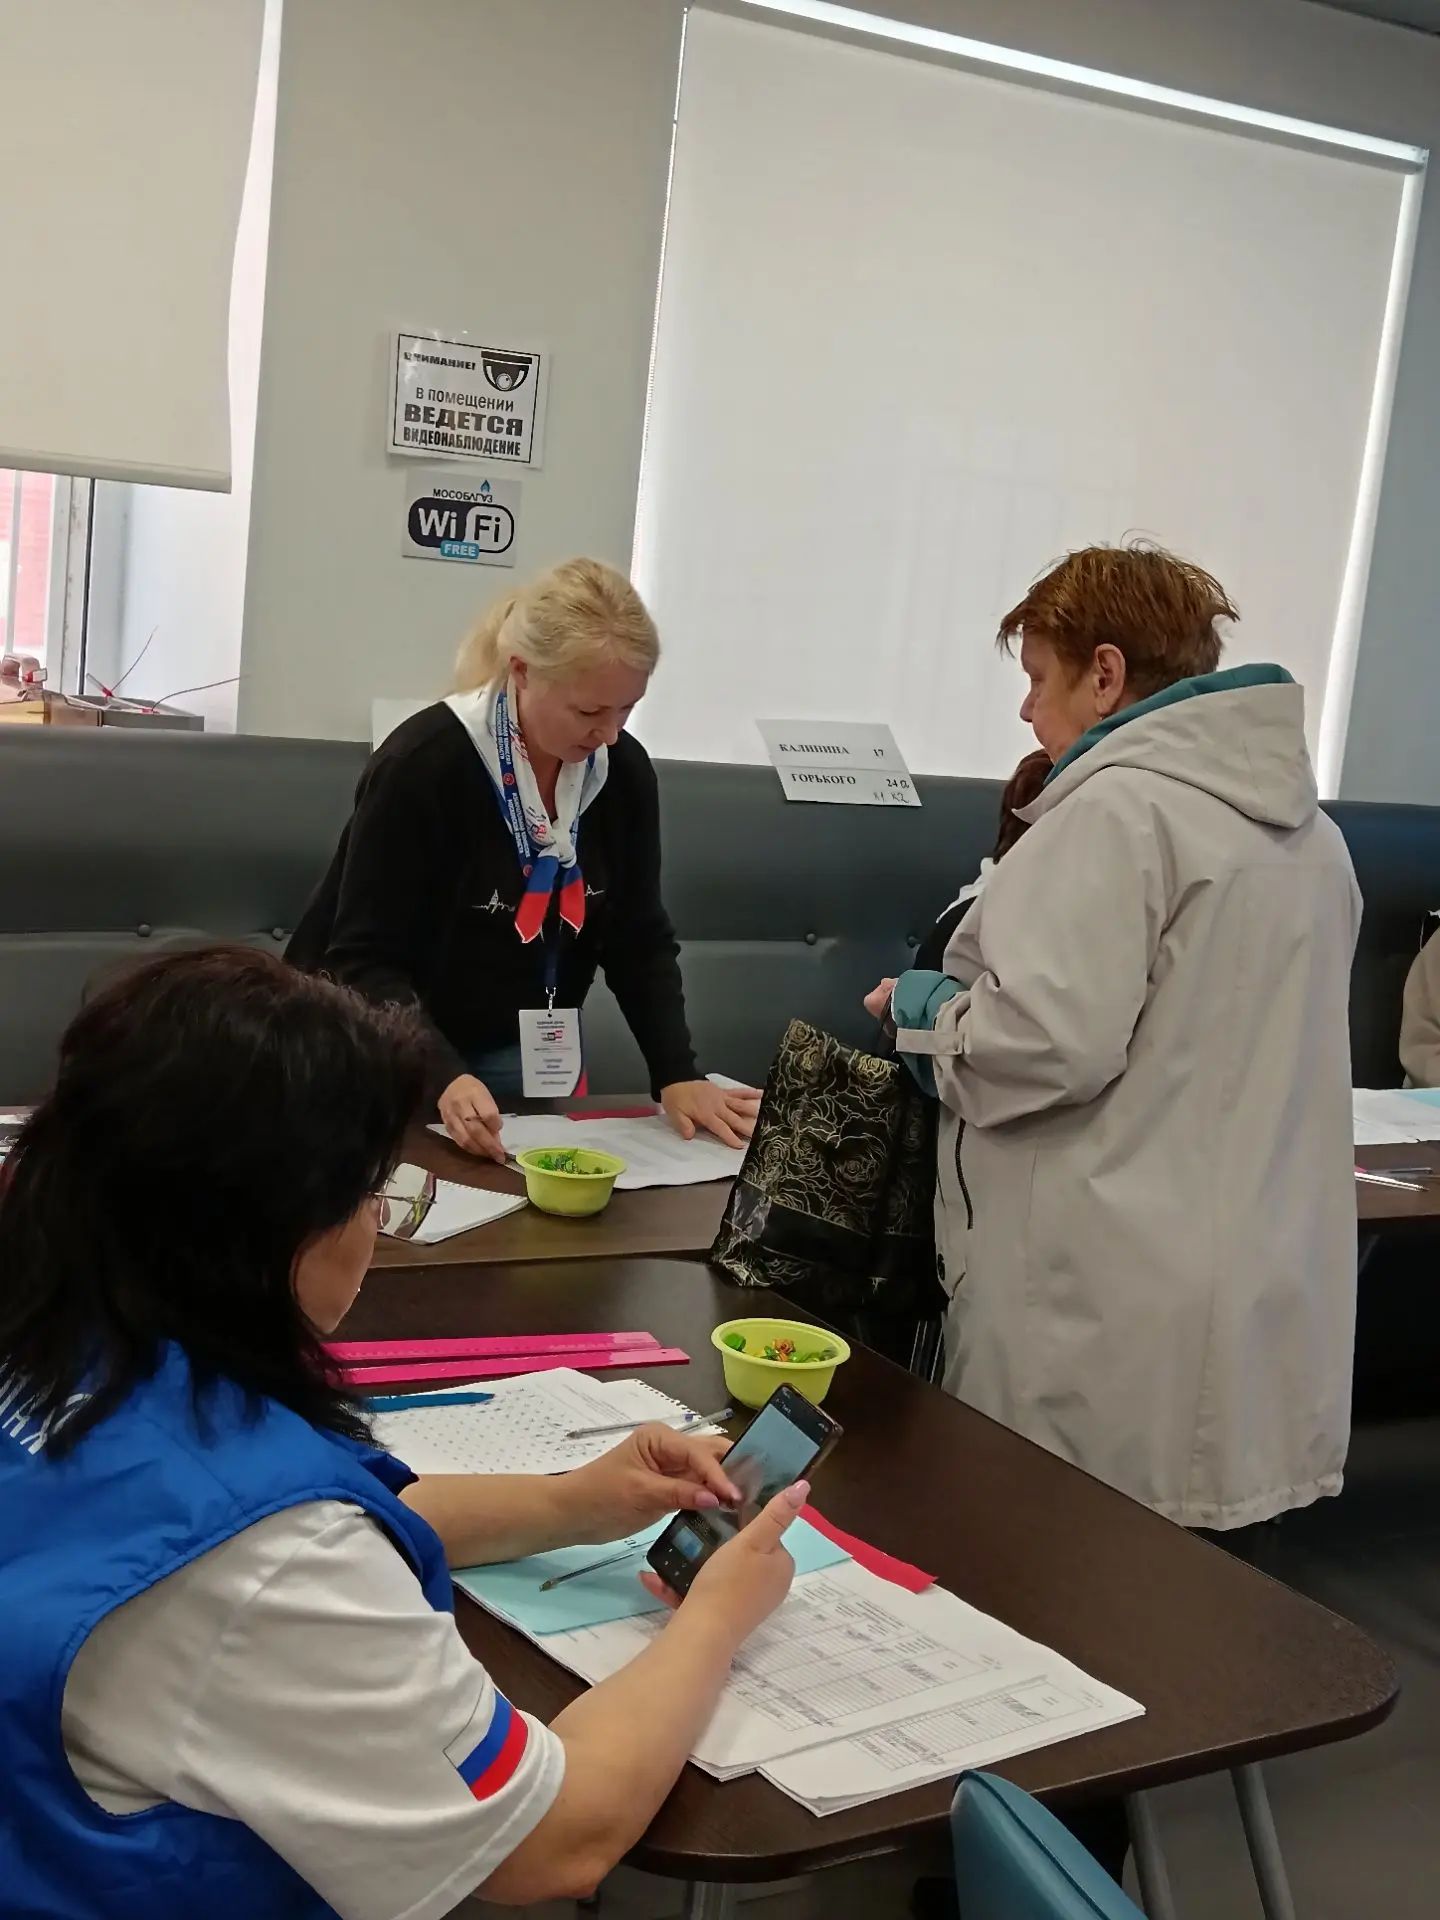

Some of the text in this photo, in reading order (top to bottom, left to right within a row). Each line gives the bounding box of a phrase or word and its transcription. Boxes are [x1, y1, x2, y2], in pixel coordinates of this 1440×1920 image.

[416, 387, 424, 400] В
[404, 403, 523, 437] ВЕДЕТСЯ
[403, 426, 521, 457] ВИДЕОНАБЛЮДЕНИЕ
[418, 508, 501, 542] Wi Fi
[444, 543, 476, 557] FREE
[779, 743, 884, 757] КАЛИНИНА 17
[791, 773, 856, 785] ГОРЬКОГО
